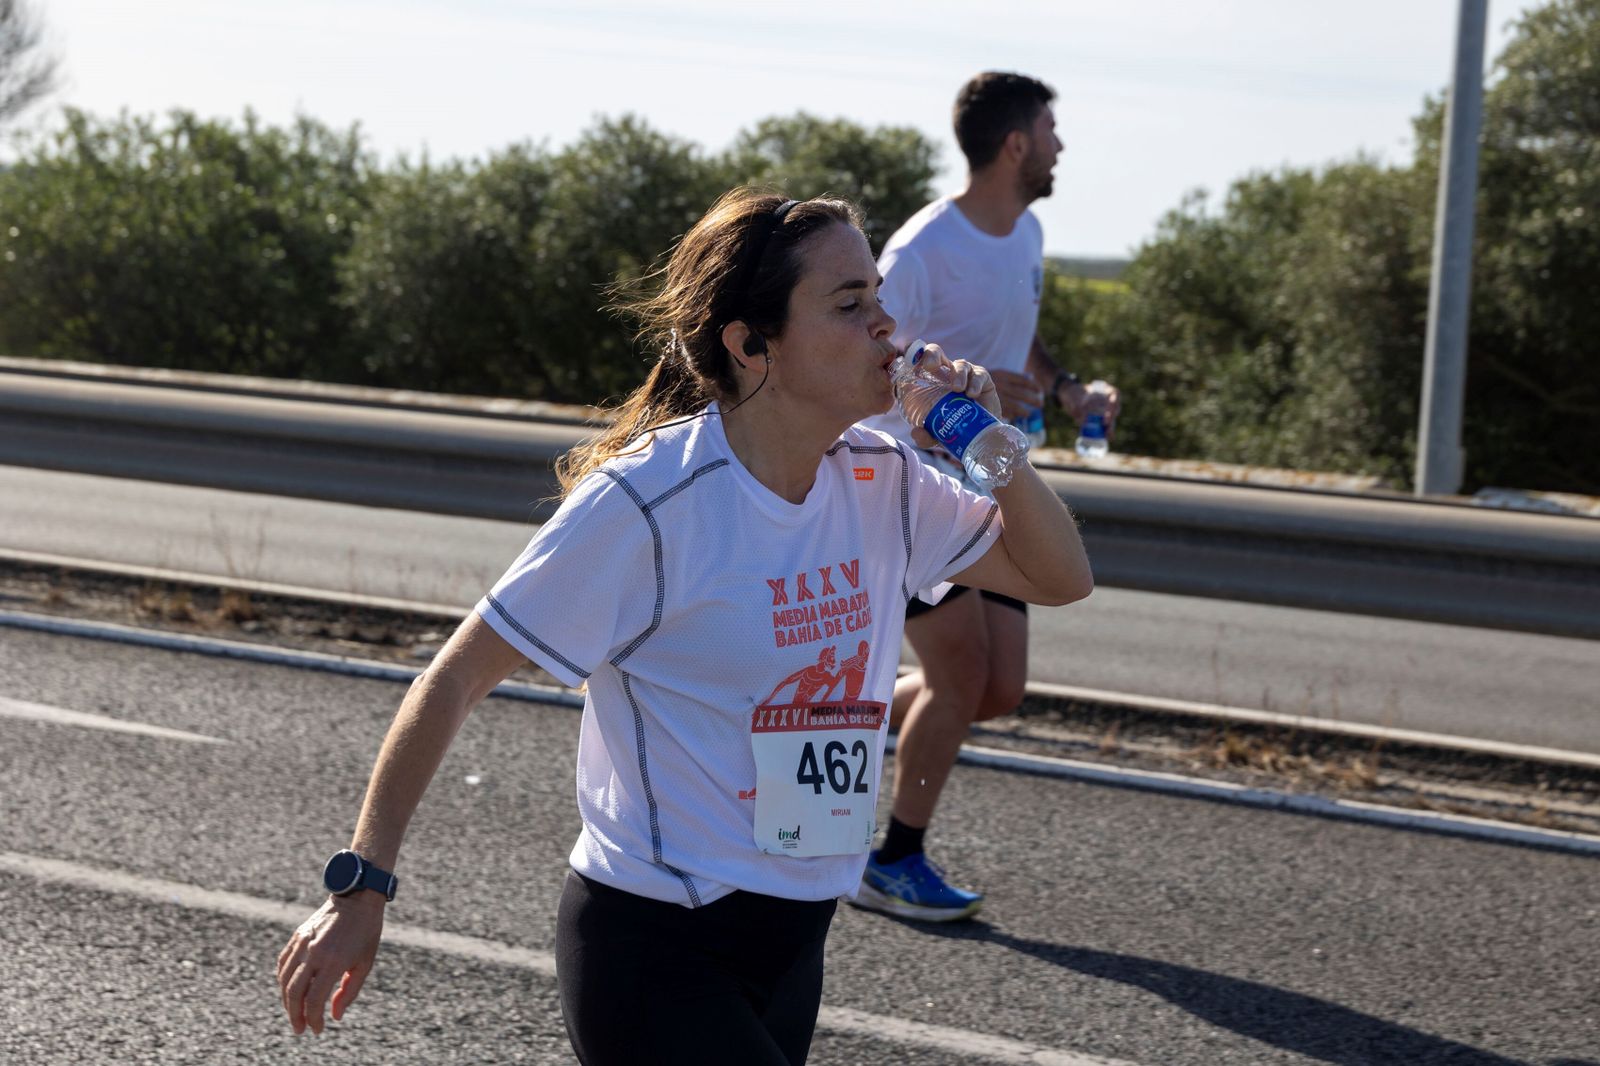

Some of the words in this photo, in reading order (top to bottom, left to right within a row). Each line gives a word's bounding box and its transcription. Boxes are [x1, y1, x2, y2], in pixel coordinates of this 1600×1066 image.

[938, 403, 973, 438] Primavera
[773, 605, 818, 628] MEDIA
[824, 618, 843, 638] DE
[756, 708, 808, 728] XXXVI
[811, 705, 844, 716] MEDIA
[849, 714, 862, 724] DE
[797, 740, 868, 795] 462
[778, 825, 801, 840] imd
